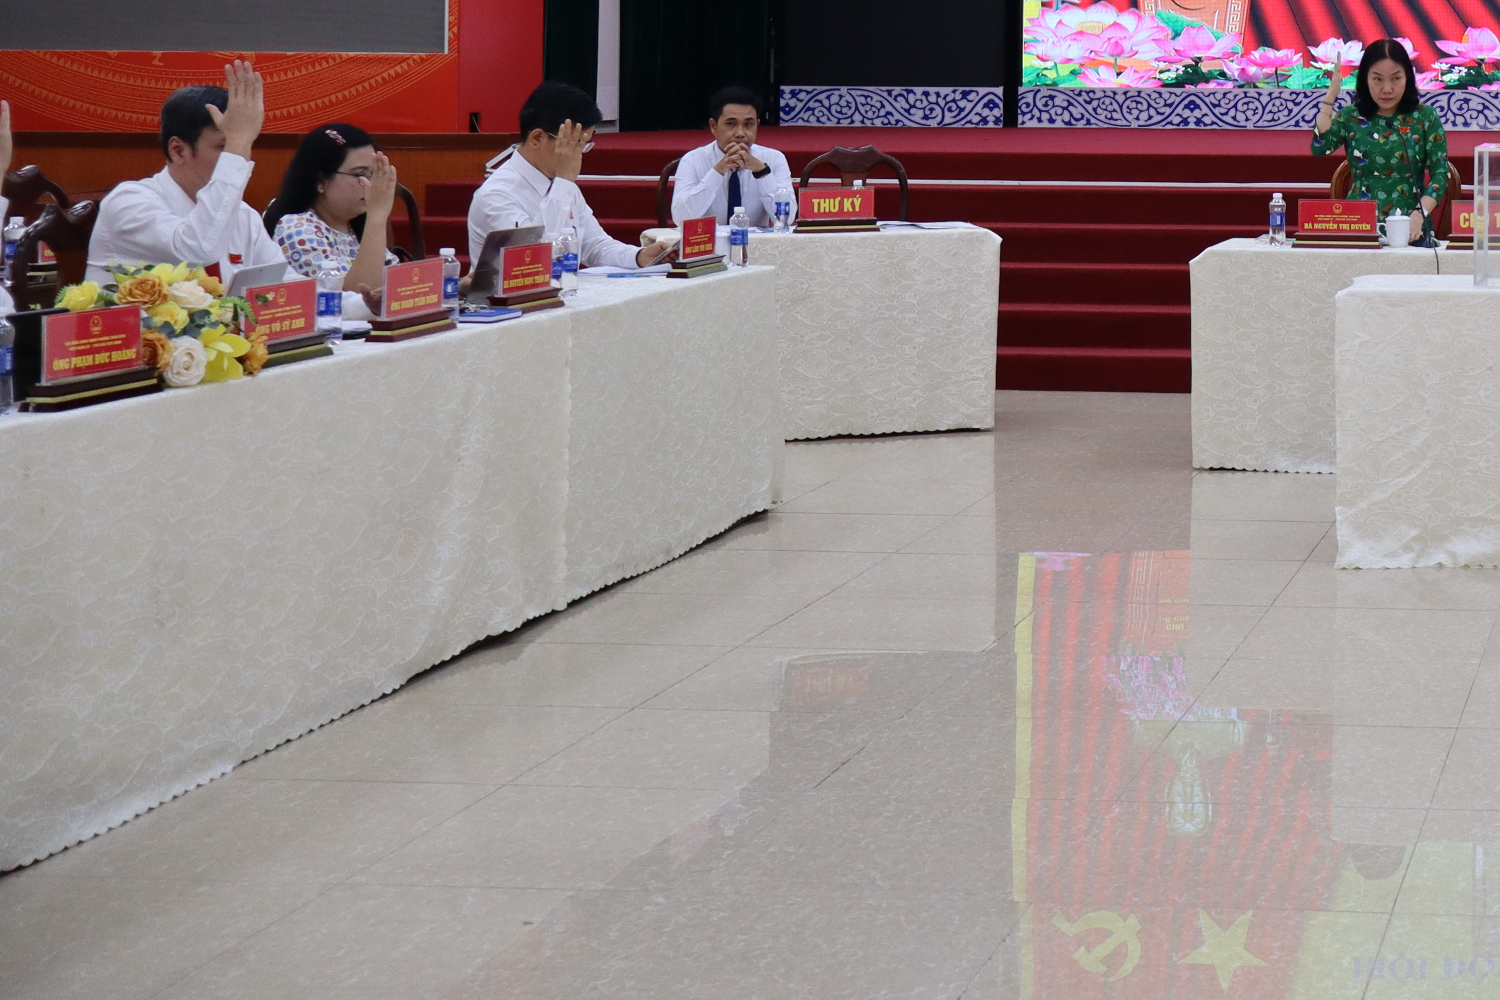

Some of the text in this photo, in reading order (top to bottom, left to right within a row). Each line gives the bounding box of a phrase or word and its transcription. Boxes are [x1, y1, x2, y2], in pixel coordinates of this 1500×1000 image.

[812, 195, 862, 213] THƯ KÝ
[52, 357, 70, 371] ÔNG
[71, 354, 93, 369] PHẠM
